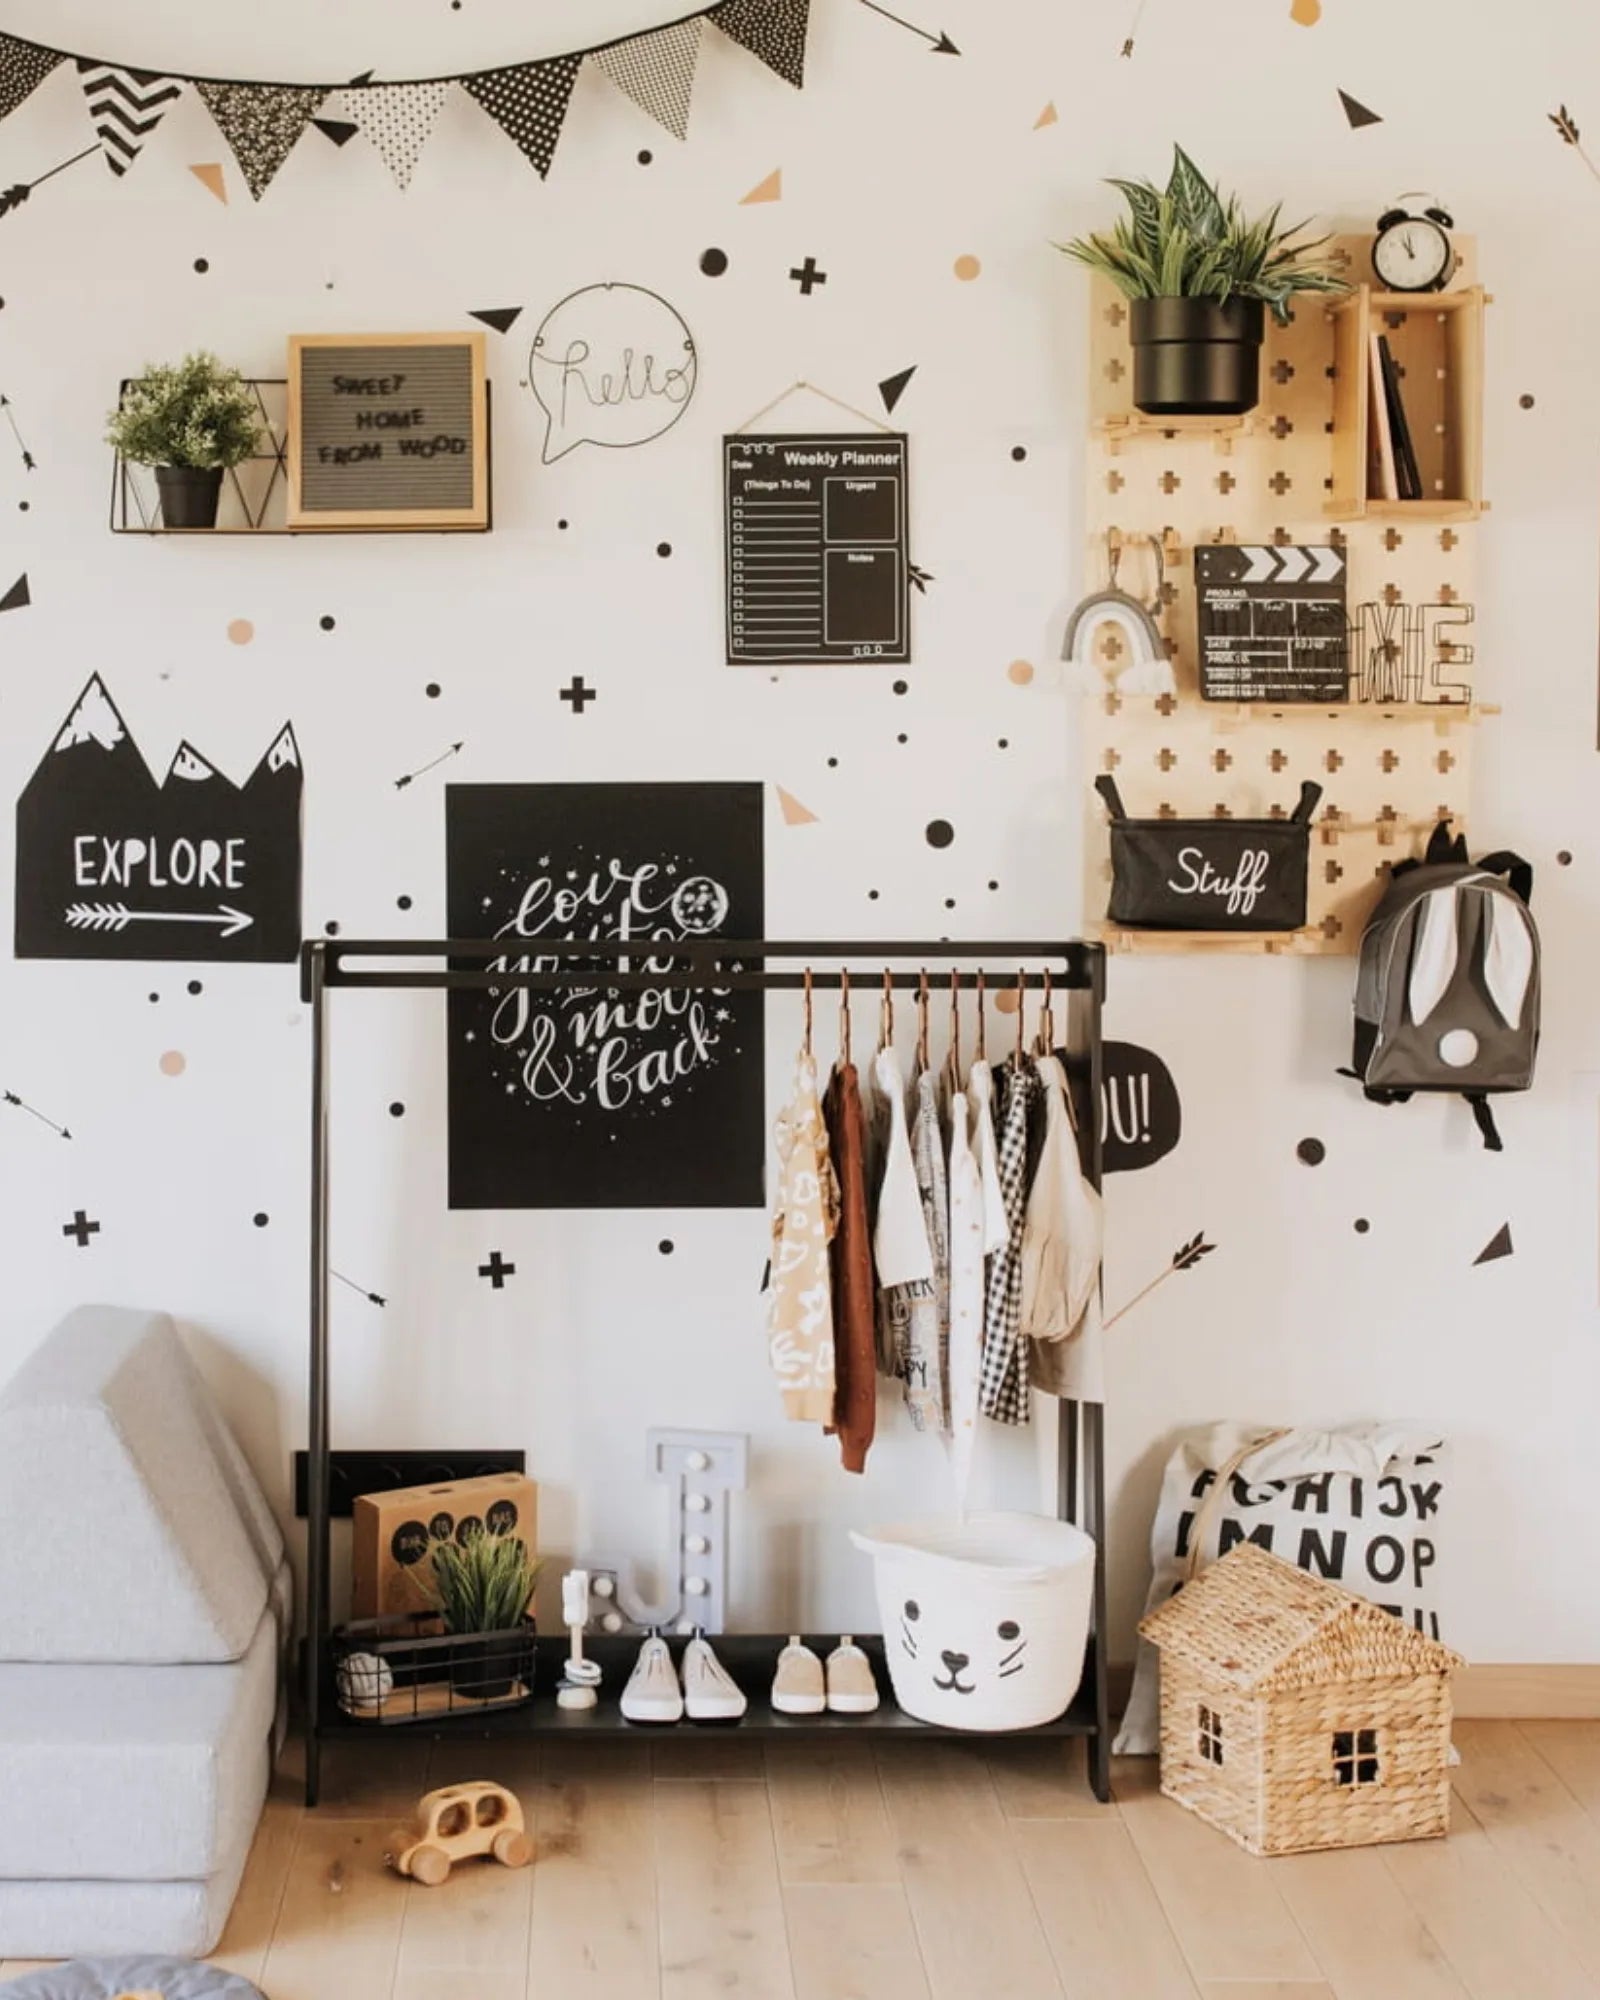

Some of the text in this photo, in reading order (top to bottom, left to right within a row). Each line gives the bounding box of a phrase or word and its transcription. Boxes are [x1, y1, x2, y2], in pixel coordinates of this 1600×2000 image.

[331, 374, 405, 396] SWEET
[540, 340, 692, 427] hello
[317, 434, 467, 465] FROM WOOD
[355, 408, 425, 431] HOME
[784, 451, 900, 468] Weekly Planner
[74, 835, 246, 889] EXPLORE
[1168, 847, 1270, 916] Stuff
[493, 858, 680, 942] love
[568, 958, 732, 1048] moo
[589, 1001, 720, 1110] back
[1101, 1072, 1151, 1144] U!
